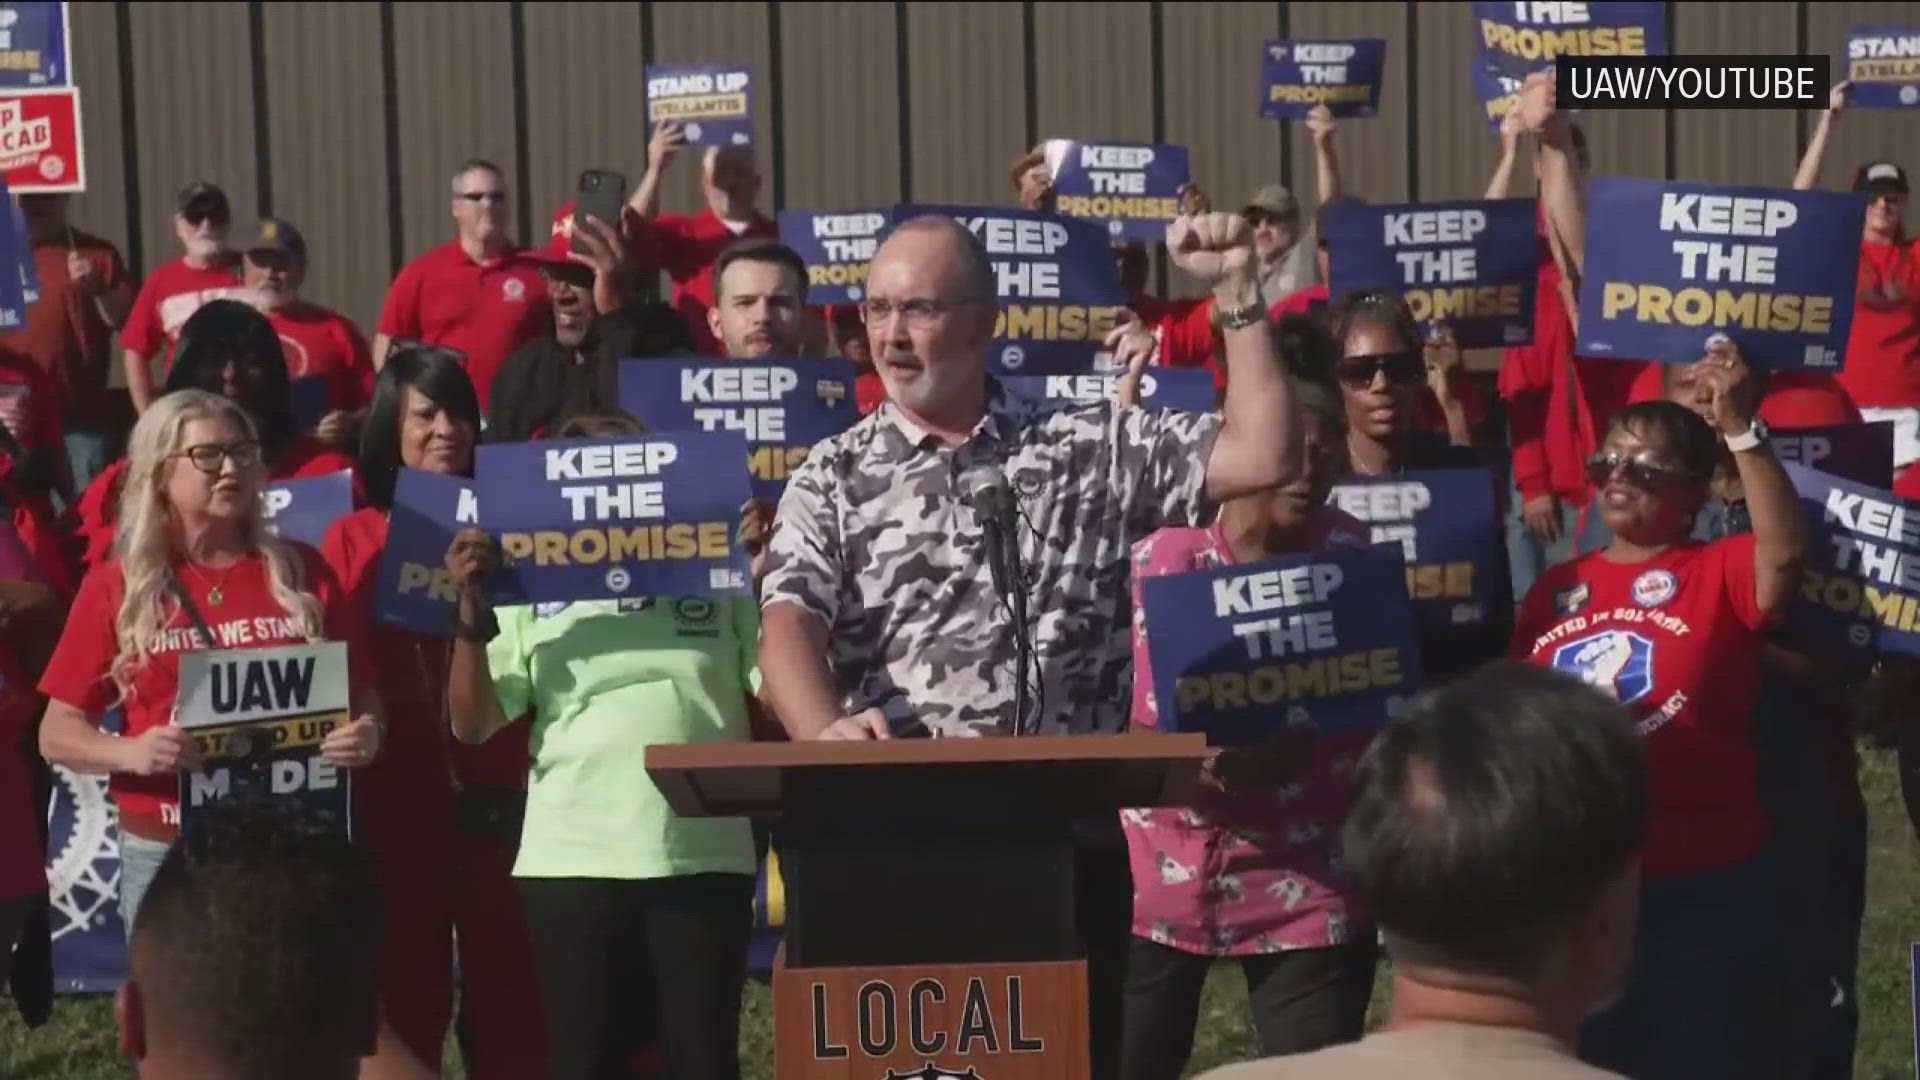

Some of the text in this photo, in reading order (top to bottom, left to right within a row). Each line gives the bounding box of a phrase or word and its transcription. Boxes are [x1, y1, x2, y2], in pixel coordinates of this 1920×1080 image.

[1294, 44, 1355, 62] KEEP
[1481, 19, 1645, 61] PROMISE
[1848, 36, 1920, 58] STAN
[647, 72, 749, 98] STAND UP
[1300, 65, 1347, 83] THE
[1081, 146, 1155, 168] KEEP
[1089, 172, 1146, 193] THE
[1056, 195, 1178, 218] PROMISE
[1660, 193, 1798, 236] KEEP
[812, 213, 885, 238] KEEP
[1383, 209, 1487, 246] KEEP
[822, 239, 877, 262] THE
[1395, 248, 1477, 284] THE
[1673, 240, 1778, 284] THE
[991, 261, 1060, 297] HE
[1404, 284, 1522, 322] OMISE
[1603, 281, 1833, 334] PROMISE
[681, 366, 798, 402] KEEP
[694, 407, 786, 441] THE
[545, 441, 678, 481] KEEP
[561, 481, 666, 522] THE
[1325, 482, 1431, 521] EEP
[502, 521, 730, 568] PROMISE
[1212, 563, 1344, 618] KEEP
[150, 626, 216, 654] UNITE
[218, 617, 253, 646] WE
[1232, 610, 1337, 660] THE
[211, 656, 316, 715] UAW
[1176, 648, 1403, 714] PROMISE
[194, 719, 337, 755] STD UP
[191, 755, 338, 807] MDE
[812, 975, 1045, 1060] LOCAL
